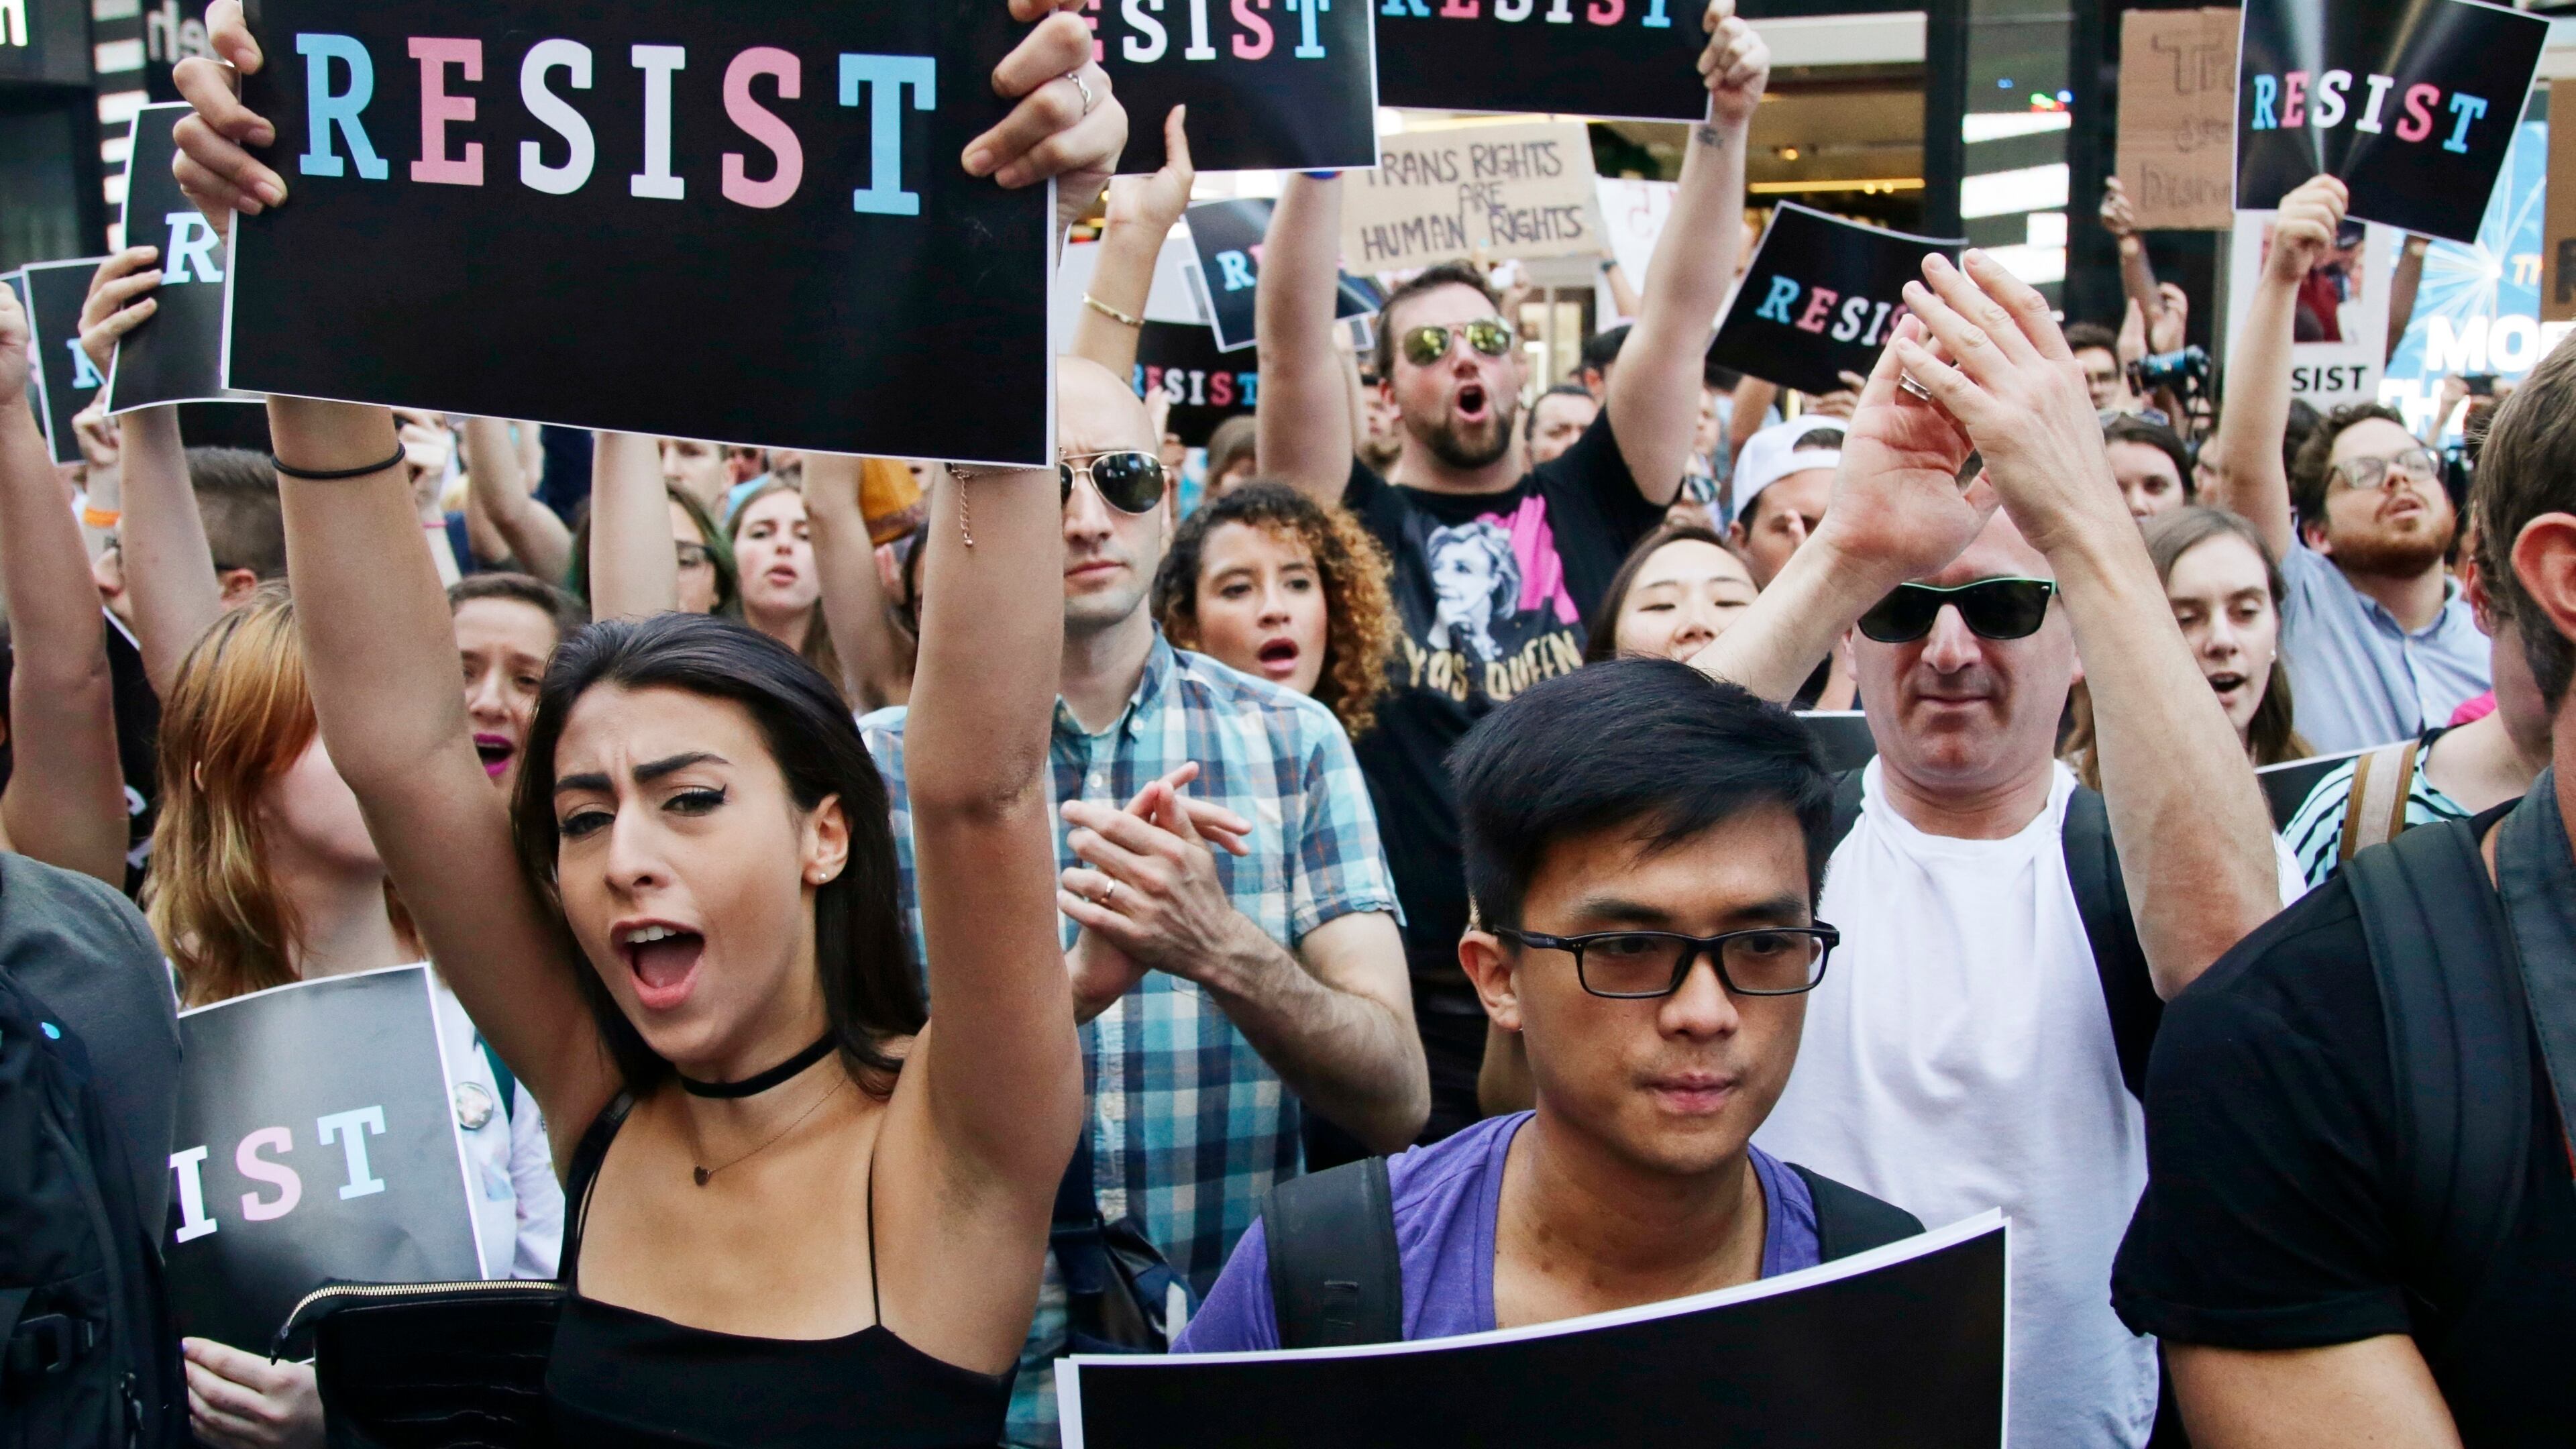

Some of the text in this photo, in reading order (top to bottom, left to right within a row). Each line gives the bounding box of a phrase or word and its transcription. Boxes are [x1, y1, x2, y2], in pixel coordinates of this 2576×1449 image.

[296, 33, 936, 216] RESIST
[2251, 68, 2489, 154] RESIST
[1469, 140, 1563, 179] RIGHTS
[1361, 212, 1467, 262] HUMAN
[1487, 204, 1584, 246] RIGHTS
[1459, 180, 1505, 220] ARE
[1402, 629, 1584, 702] YAS QUEEN
[169, 1104, 386, 1244] IST
